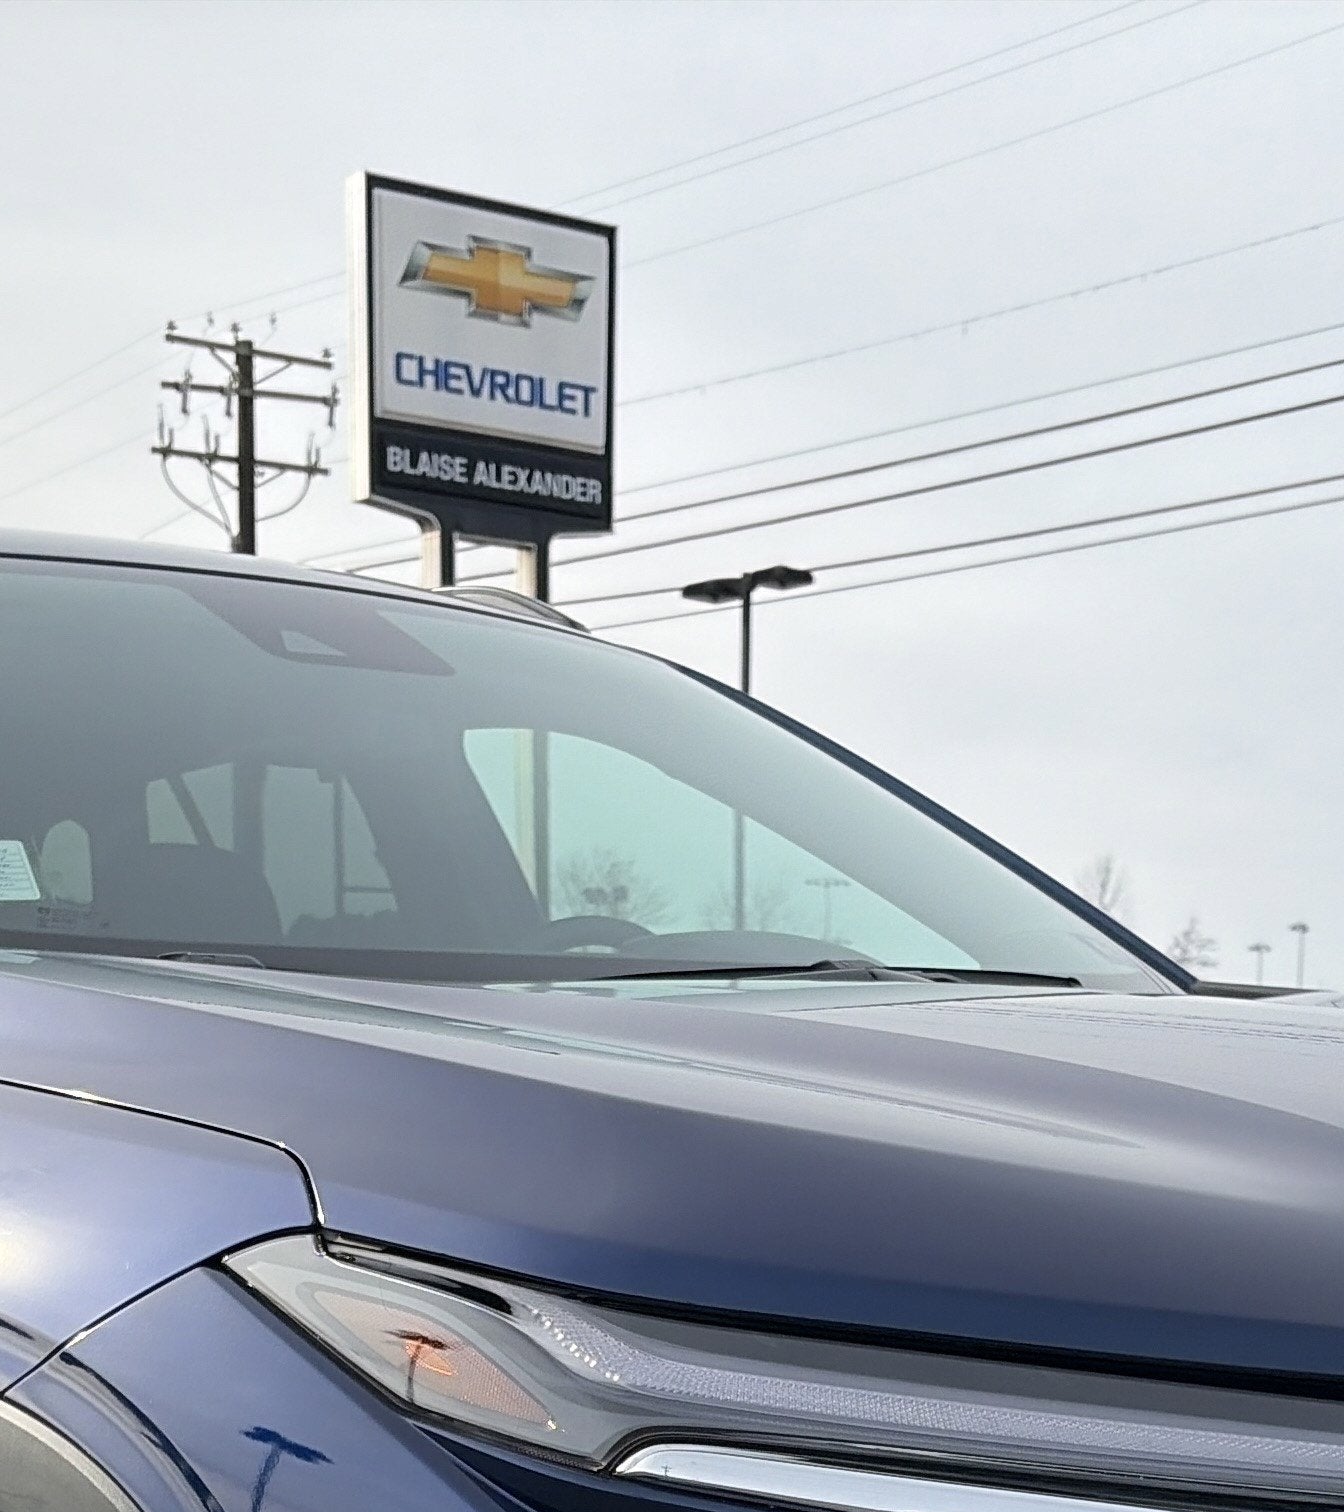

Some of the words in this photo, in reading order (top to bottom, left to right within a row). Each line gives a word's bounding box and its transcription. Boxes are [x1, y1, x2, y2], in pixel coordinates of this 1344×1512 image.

[395, 352, 597, 417] CHEVROLET
[386, 446, 469, 483] BLAISE
[473, 461, 602, 504] ALEXANDER
